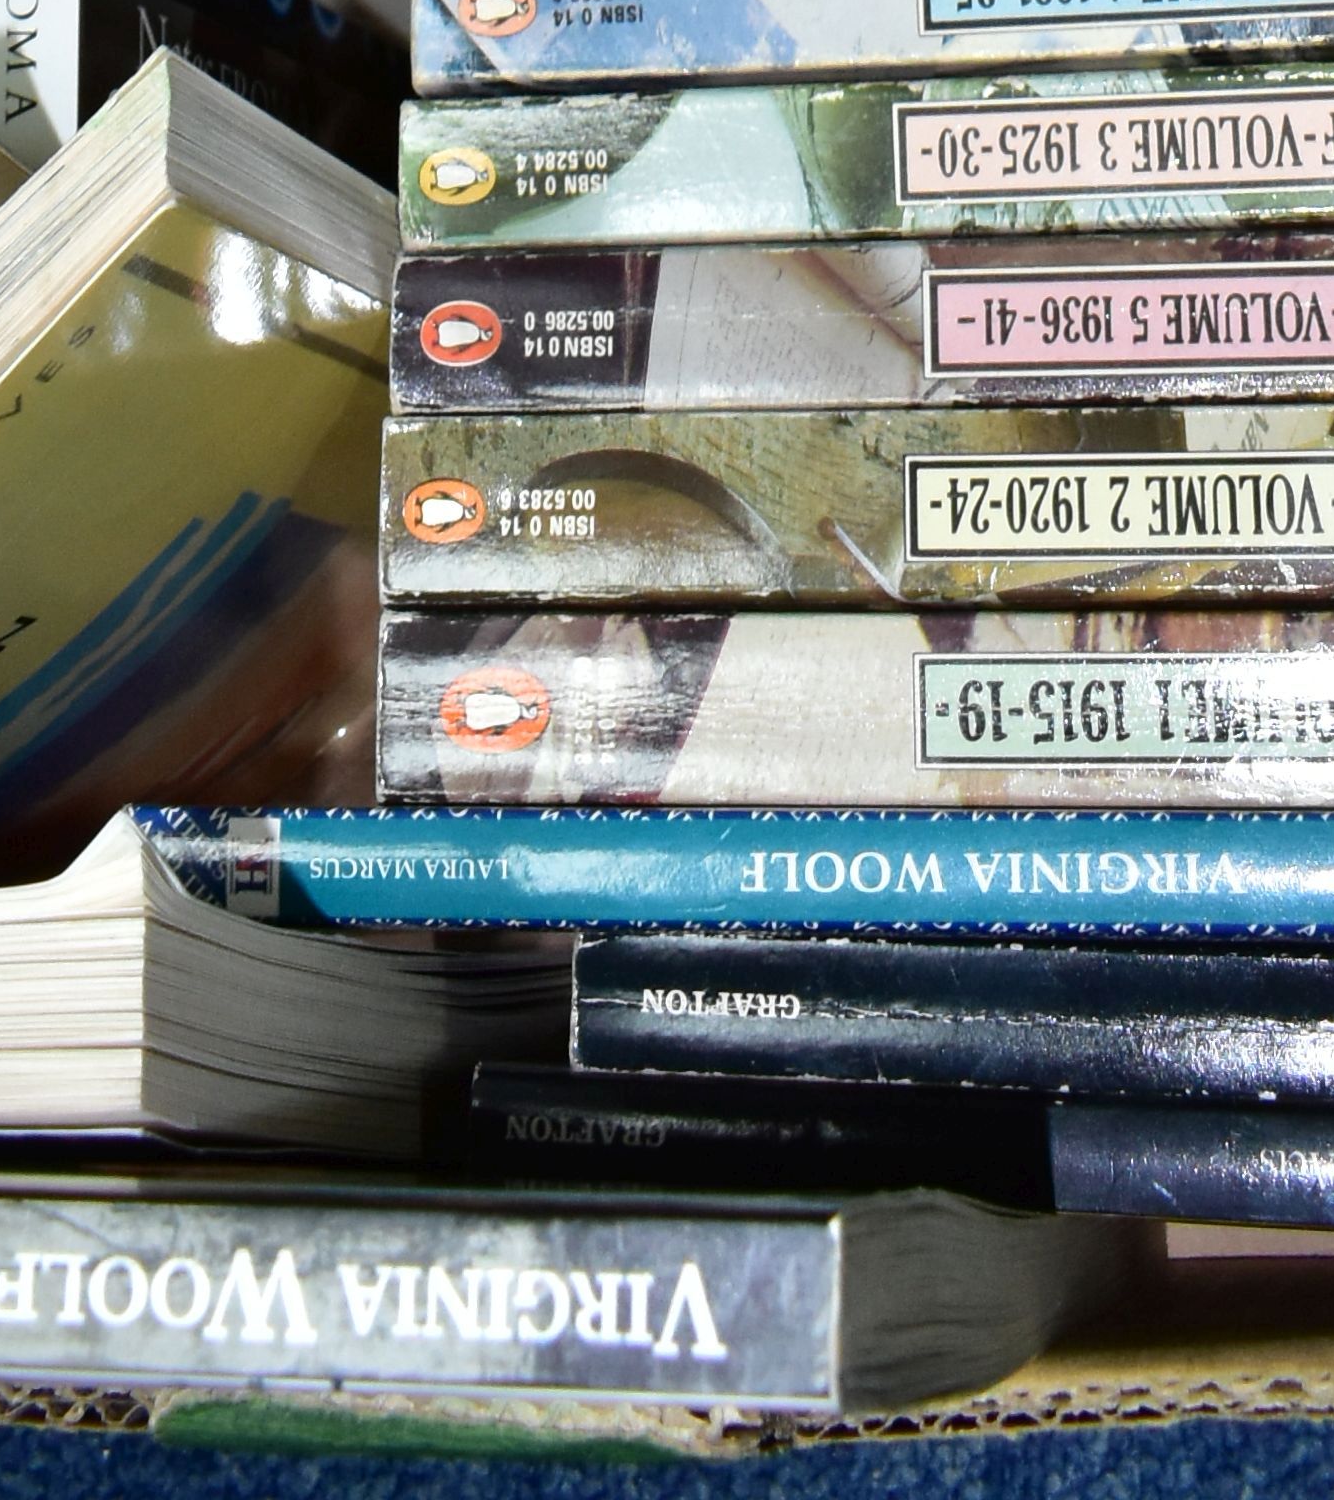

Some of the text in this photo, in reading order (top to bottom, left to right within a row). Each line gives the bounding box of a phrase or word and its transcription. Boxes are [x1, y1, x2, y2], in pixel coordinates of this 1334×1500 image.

[1128, 295, 1151, 345] 5
[564, 336, 615, 359] ISBN
[307, 856, 417, 882] MARCUS
[424, 856, 510, 882] LAURA
[738, 850, 946, 894] WOOLF
[964, 850, 1249, 896] VIRGINIA
[640, 986, 803, 1021] GRAFTON
[336, 1262, 729, 1360] VIRGINIA
